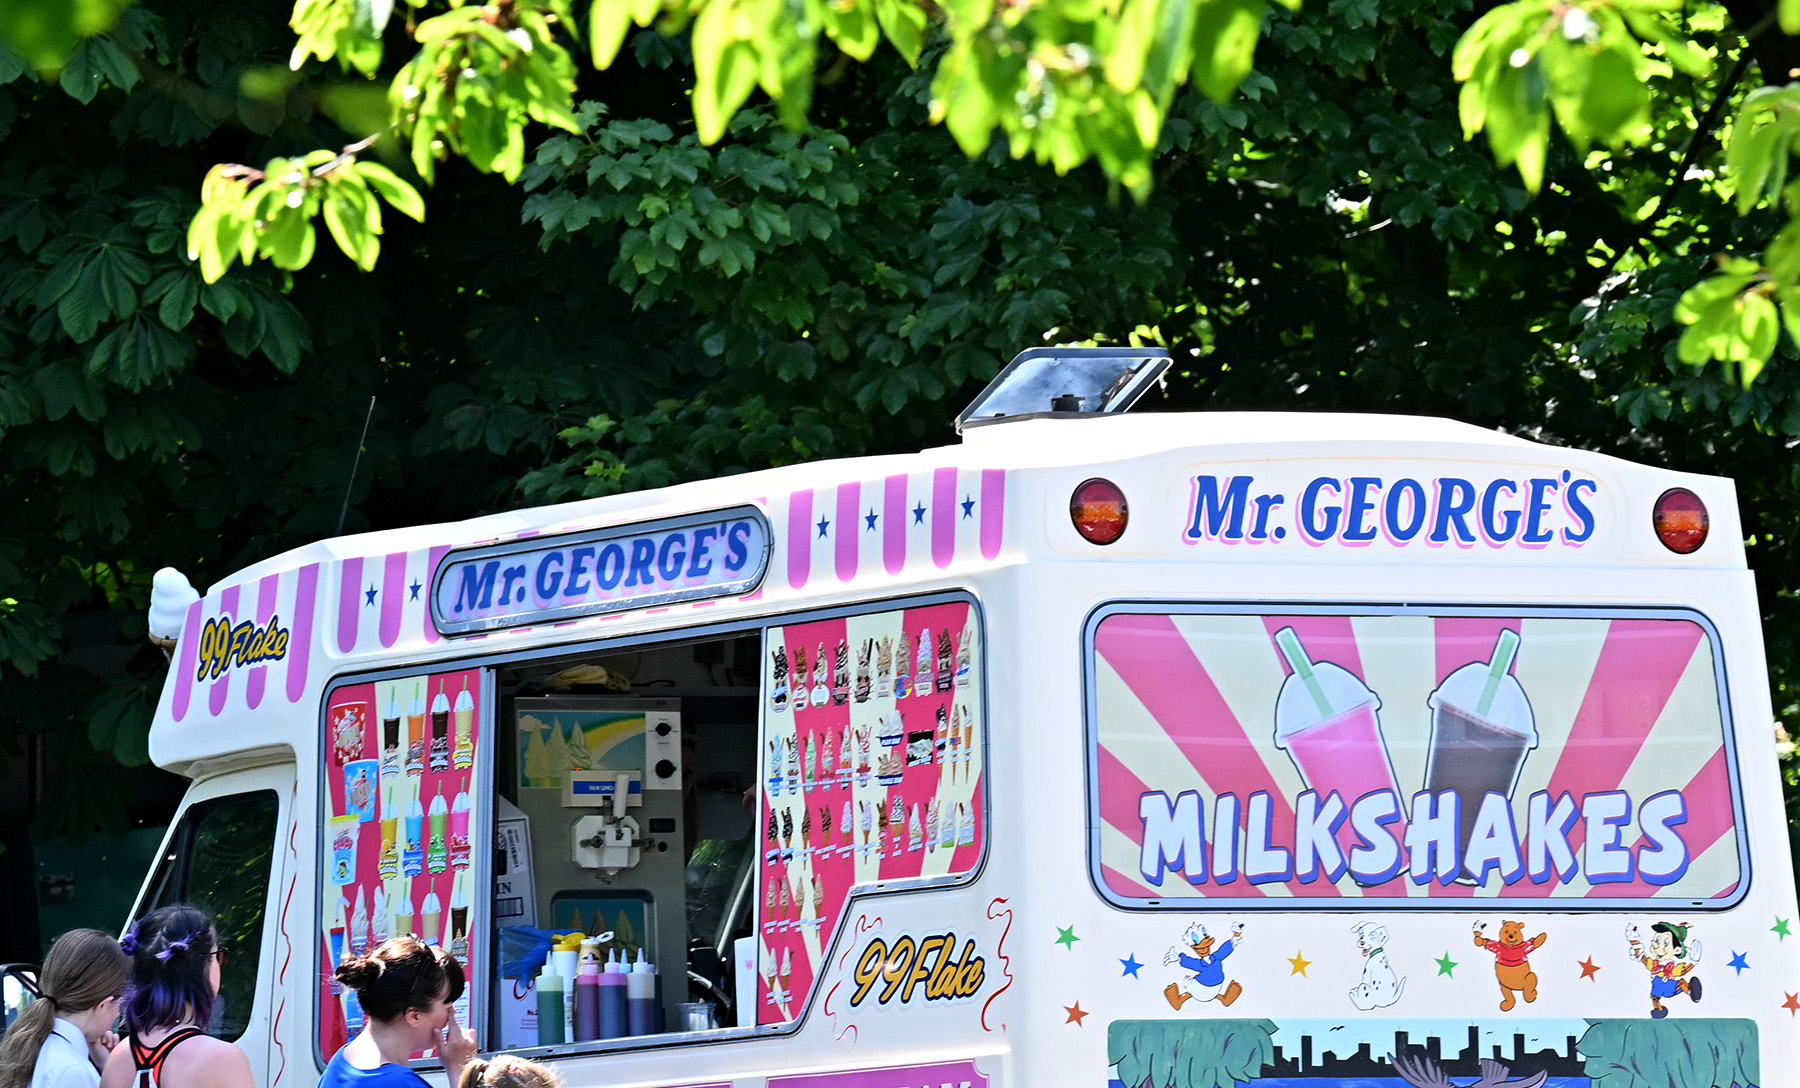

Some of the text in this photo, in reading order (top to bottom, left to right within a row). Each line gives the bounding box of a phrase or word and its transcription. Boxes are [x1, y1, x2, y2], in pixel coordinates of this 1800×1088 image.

[1183, 469, 1597, 548] Mr. GEORGE'S
[453, 521, 750, 617] Mr. GEORGE'S
[1140, 789, 1688, 887] MILKSHAKES
